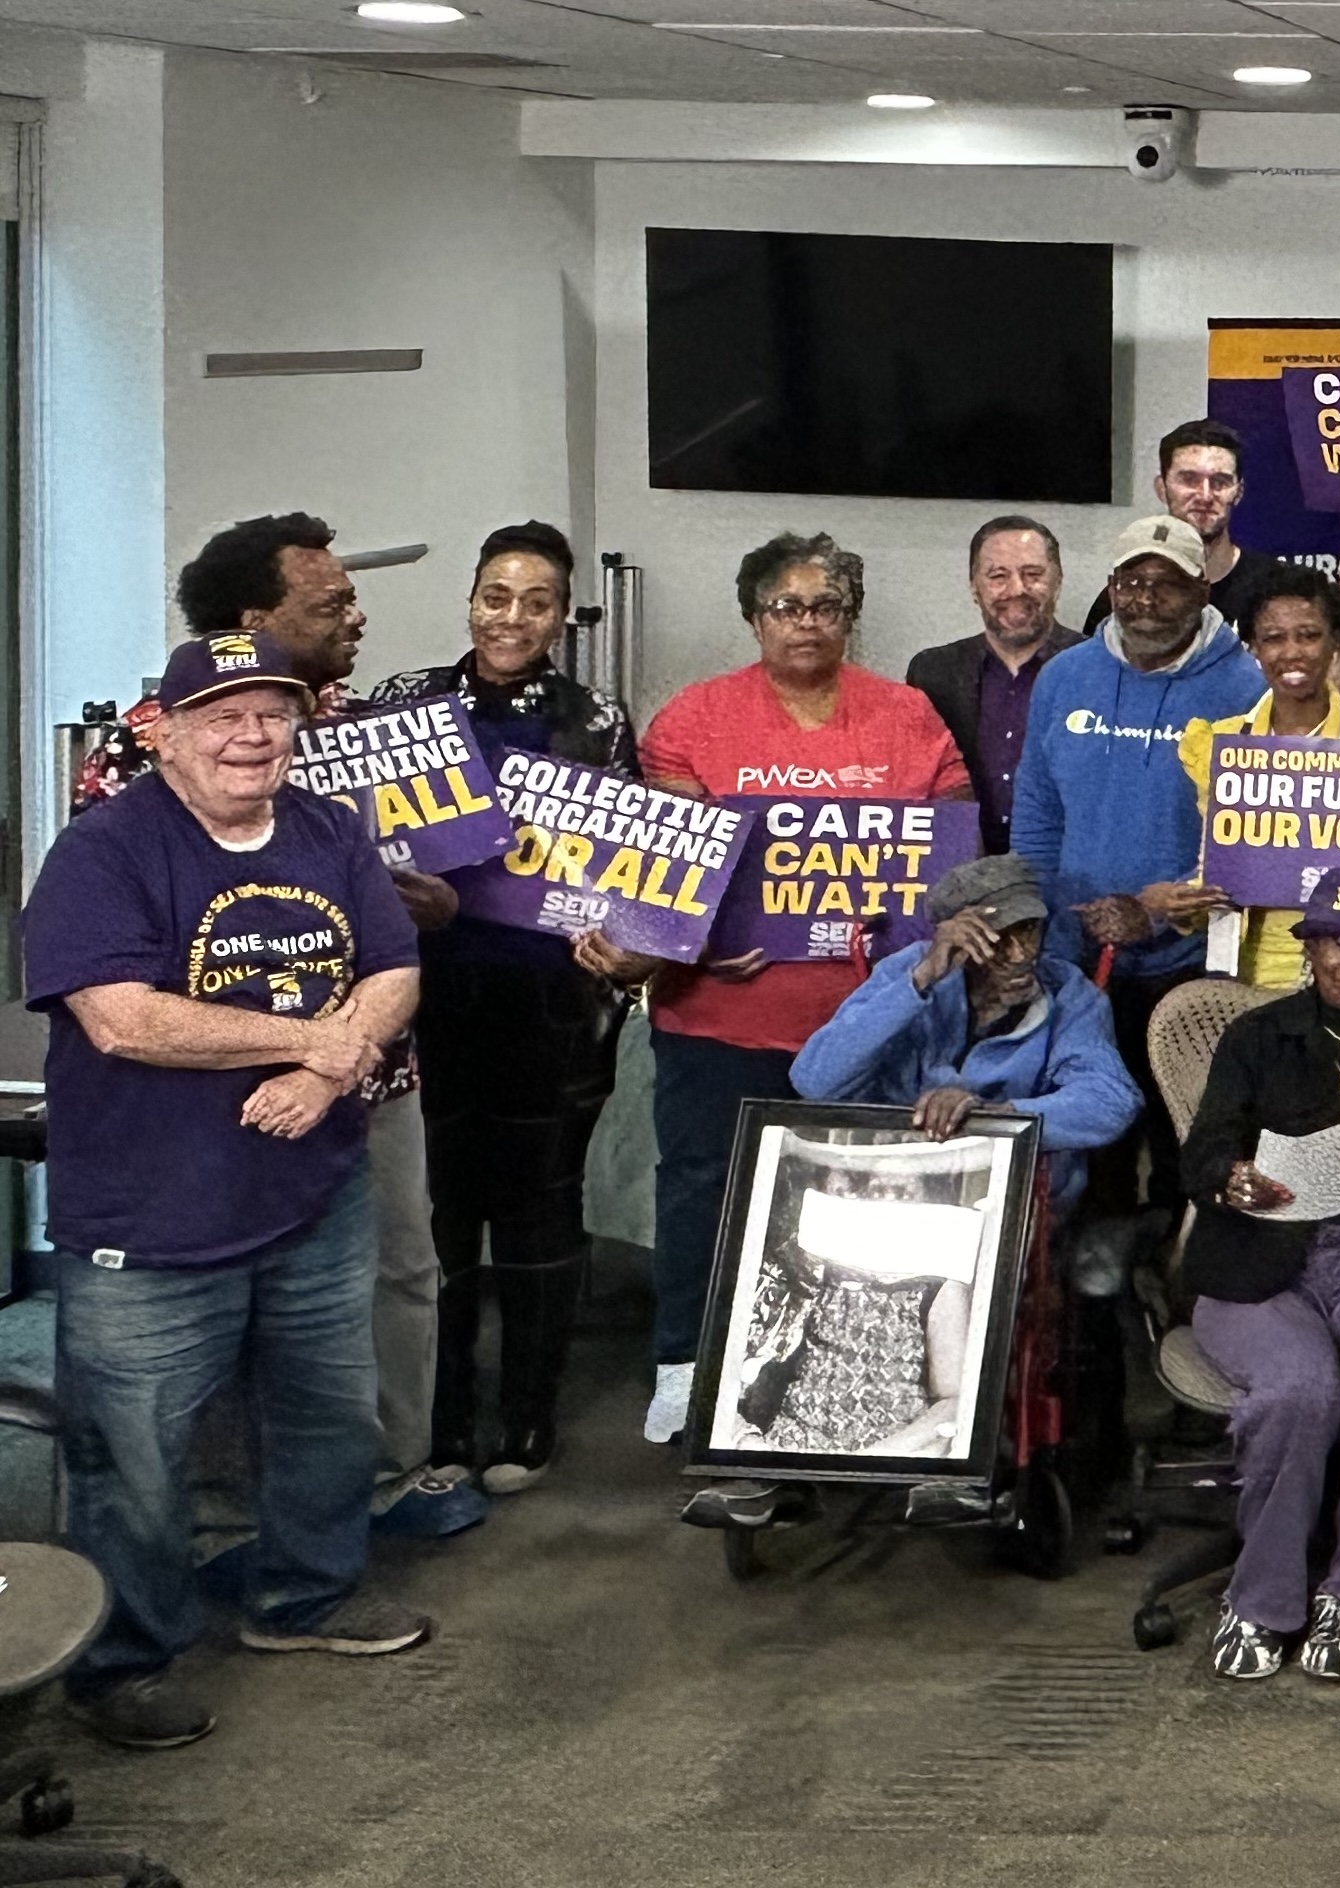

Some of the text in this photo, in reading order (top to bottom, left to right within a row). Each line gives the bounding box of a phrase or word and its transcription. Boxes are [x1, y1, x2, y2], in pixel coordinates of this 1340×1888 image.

[291, 701, 460, 766] LECTIVE
[288, 735, 471, 796] RGAINING
[1220, 748, 1268, 770] OUR
[373, 765, 493, 838] ALL
[499, 754, 742, 843] COLLECTIVE
[1215, 772, 1295, 808] OUR
[766, 802, 935, 840] CARE
[1212, 809, 1301, 848] OUR
[503, 823, 708, 916] OR ALL
[763, 841, 932, 878] CAN'T
[542, 889, 610, 921] SEIU
[762, 880, 928, 916] WAIT
[211, 933, 265, 957] ONE
